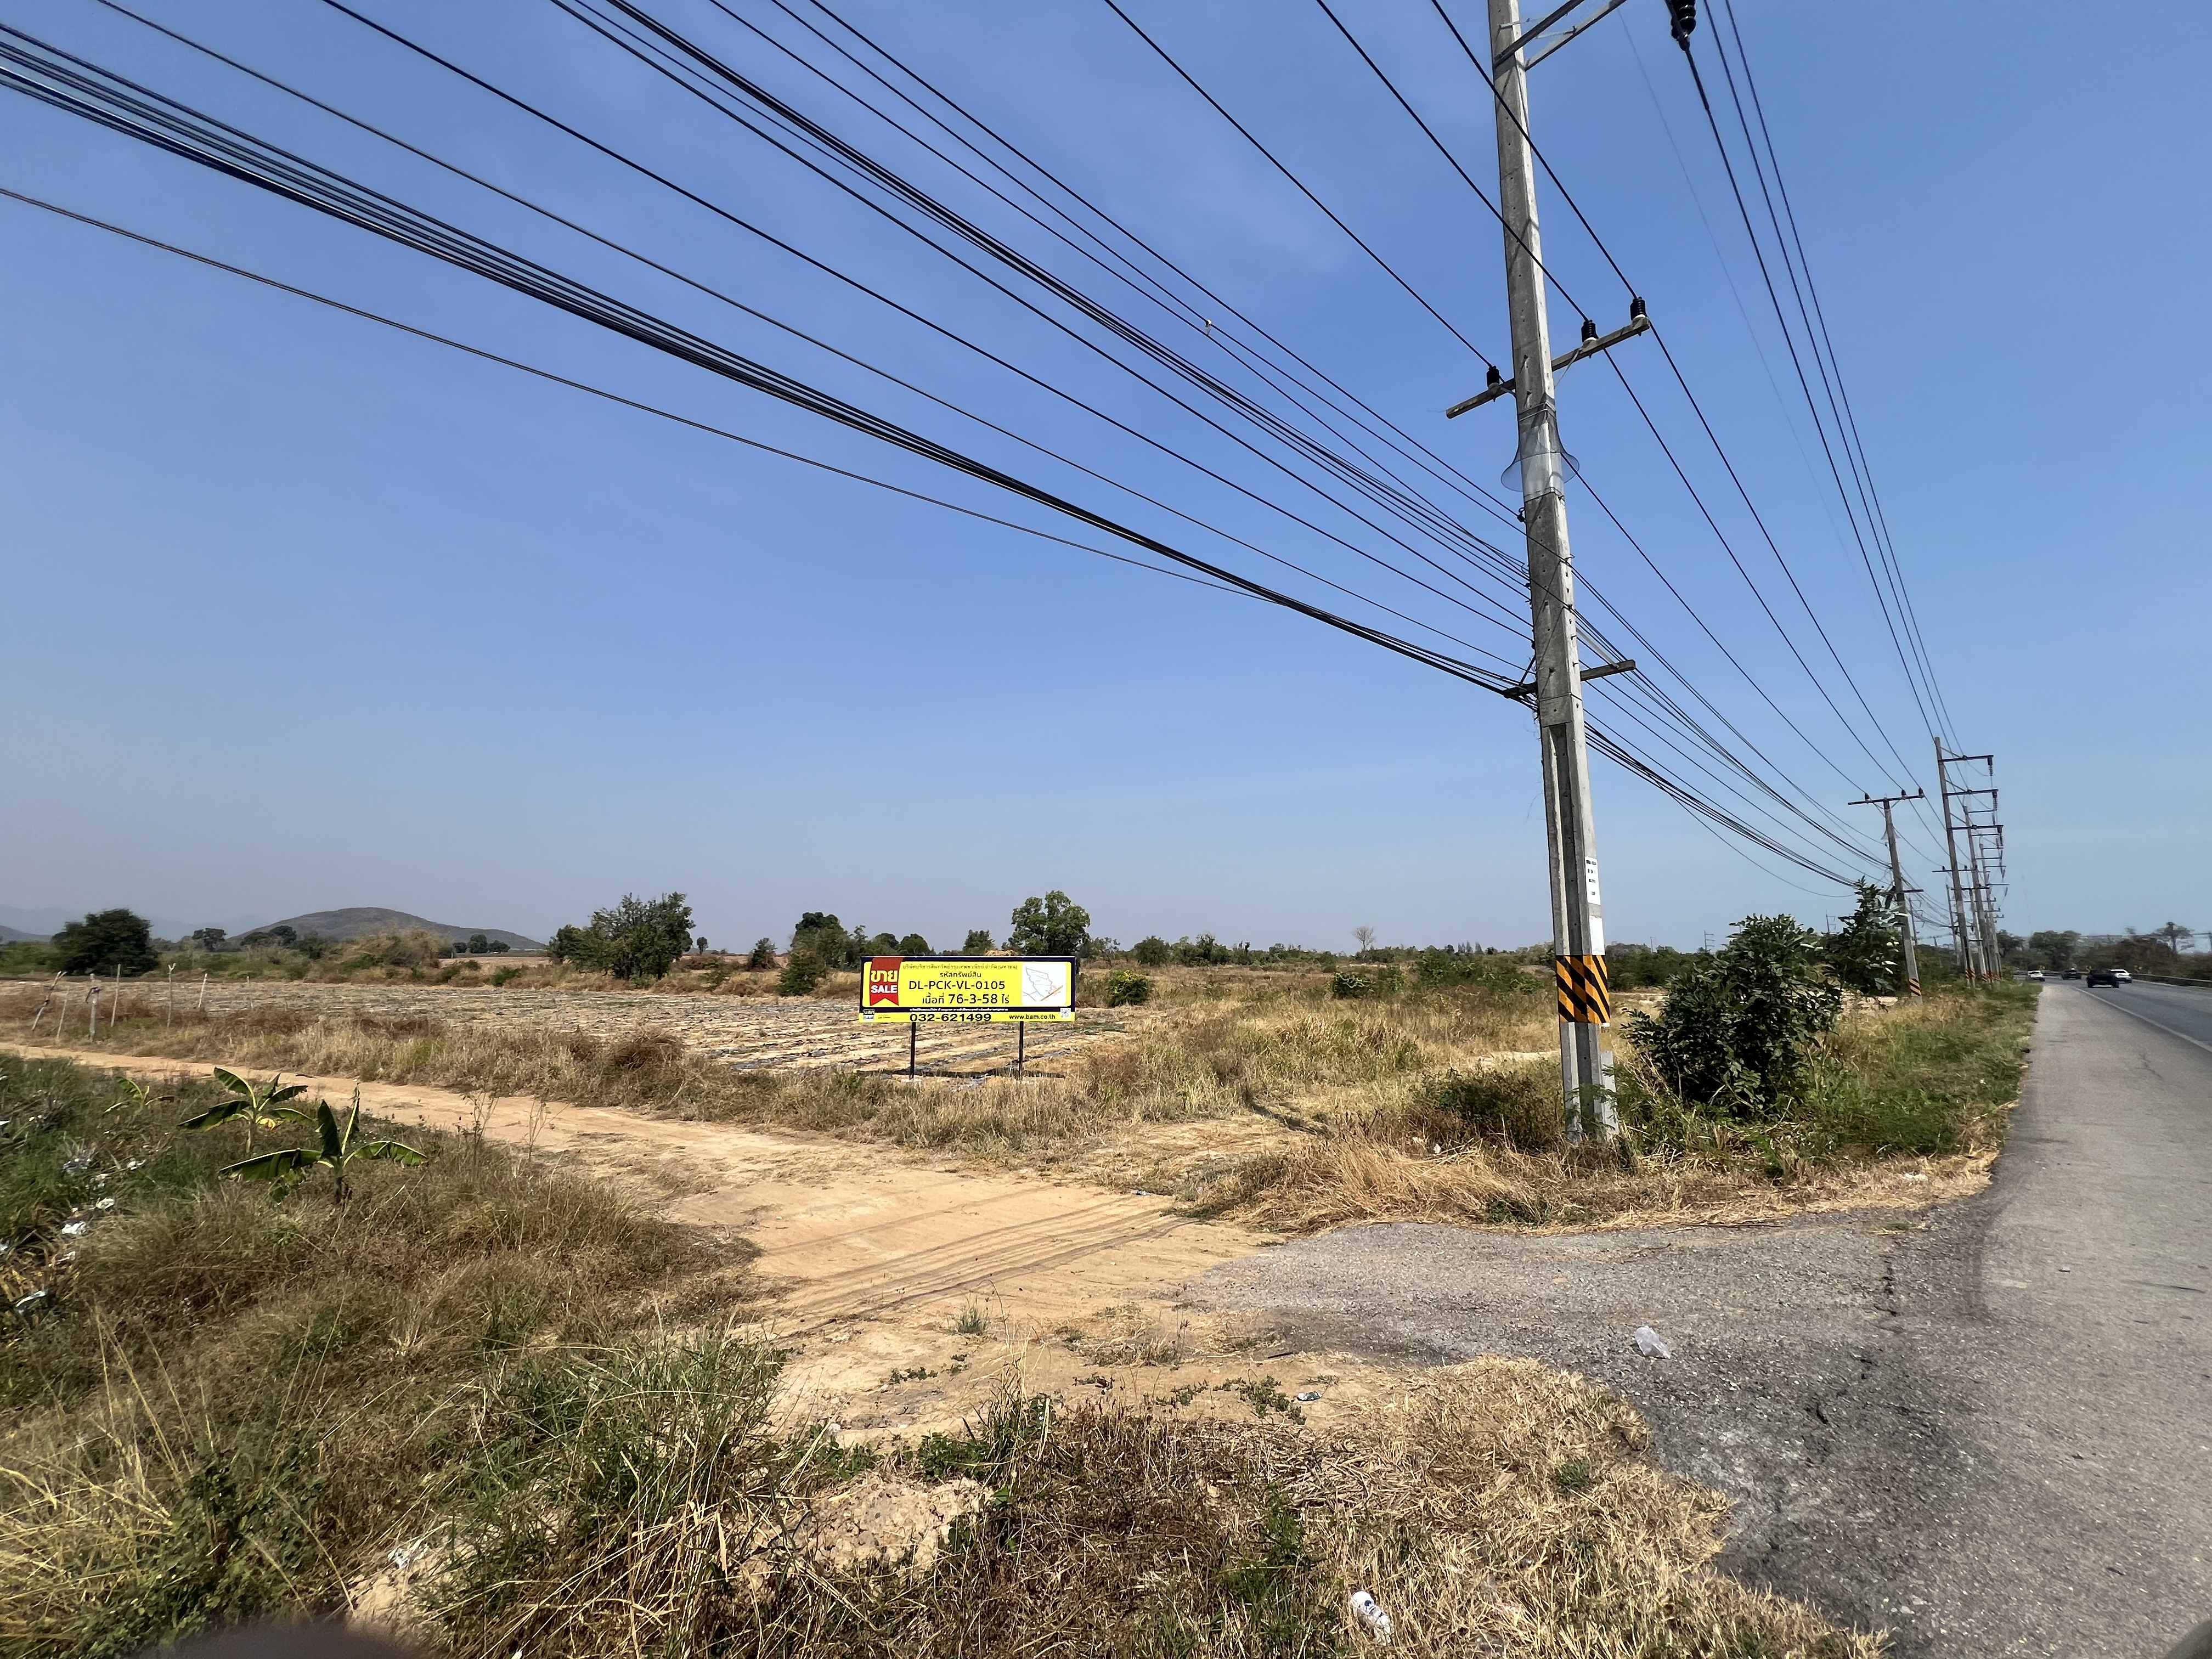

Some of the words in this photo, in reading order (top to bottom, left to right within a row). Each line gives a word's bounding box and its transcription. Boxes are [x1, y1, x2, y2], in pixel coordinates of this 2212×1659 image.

[871, 970, 898, 983] ขาย
[871, 985, 898, 994] SALE
[909, 980, 1005, 990] DL-PCK-VL-0105
[922, 992, 944, 1004] เนื้อที่
[949, 994, 997, 1004] 76-3-58
[910, 1013, 991, 1022] 032-621499
